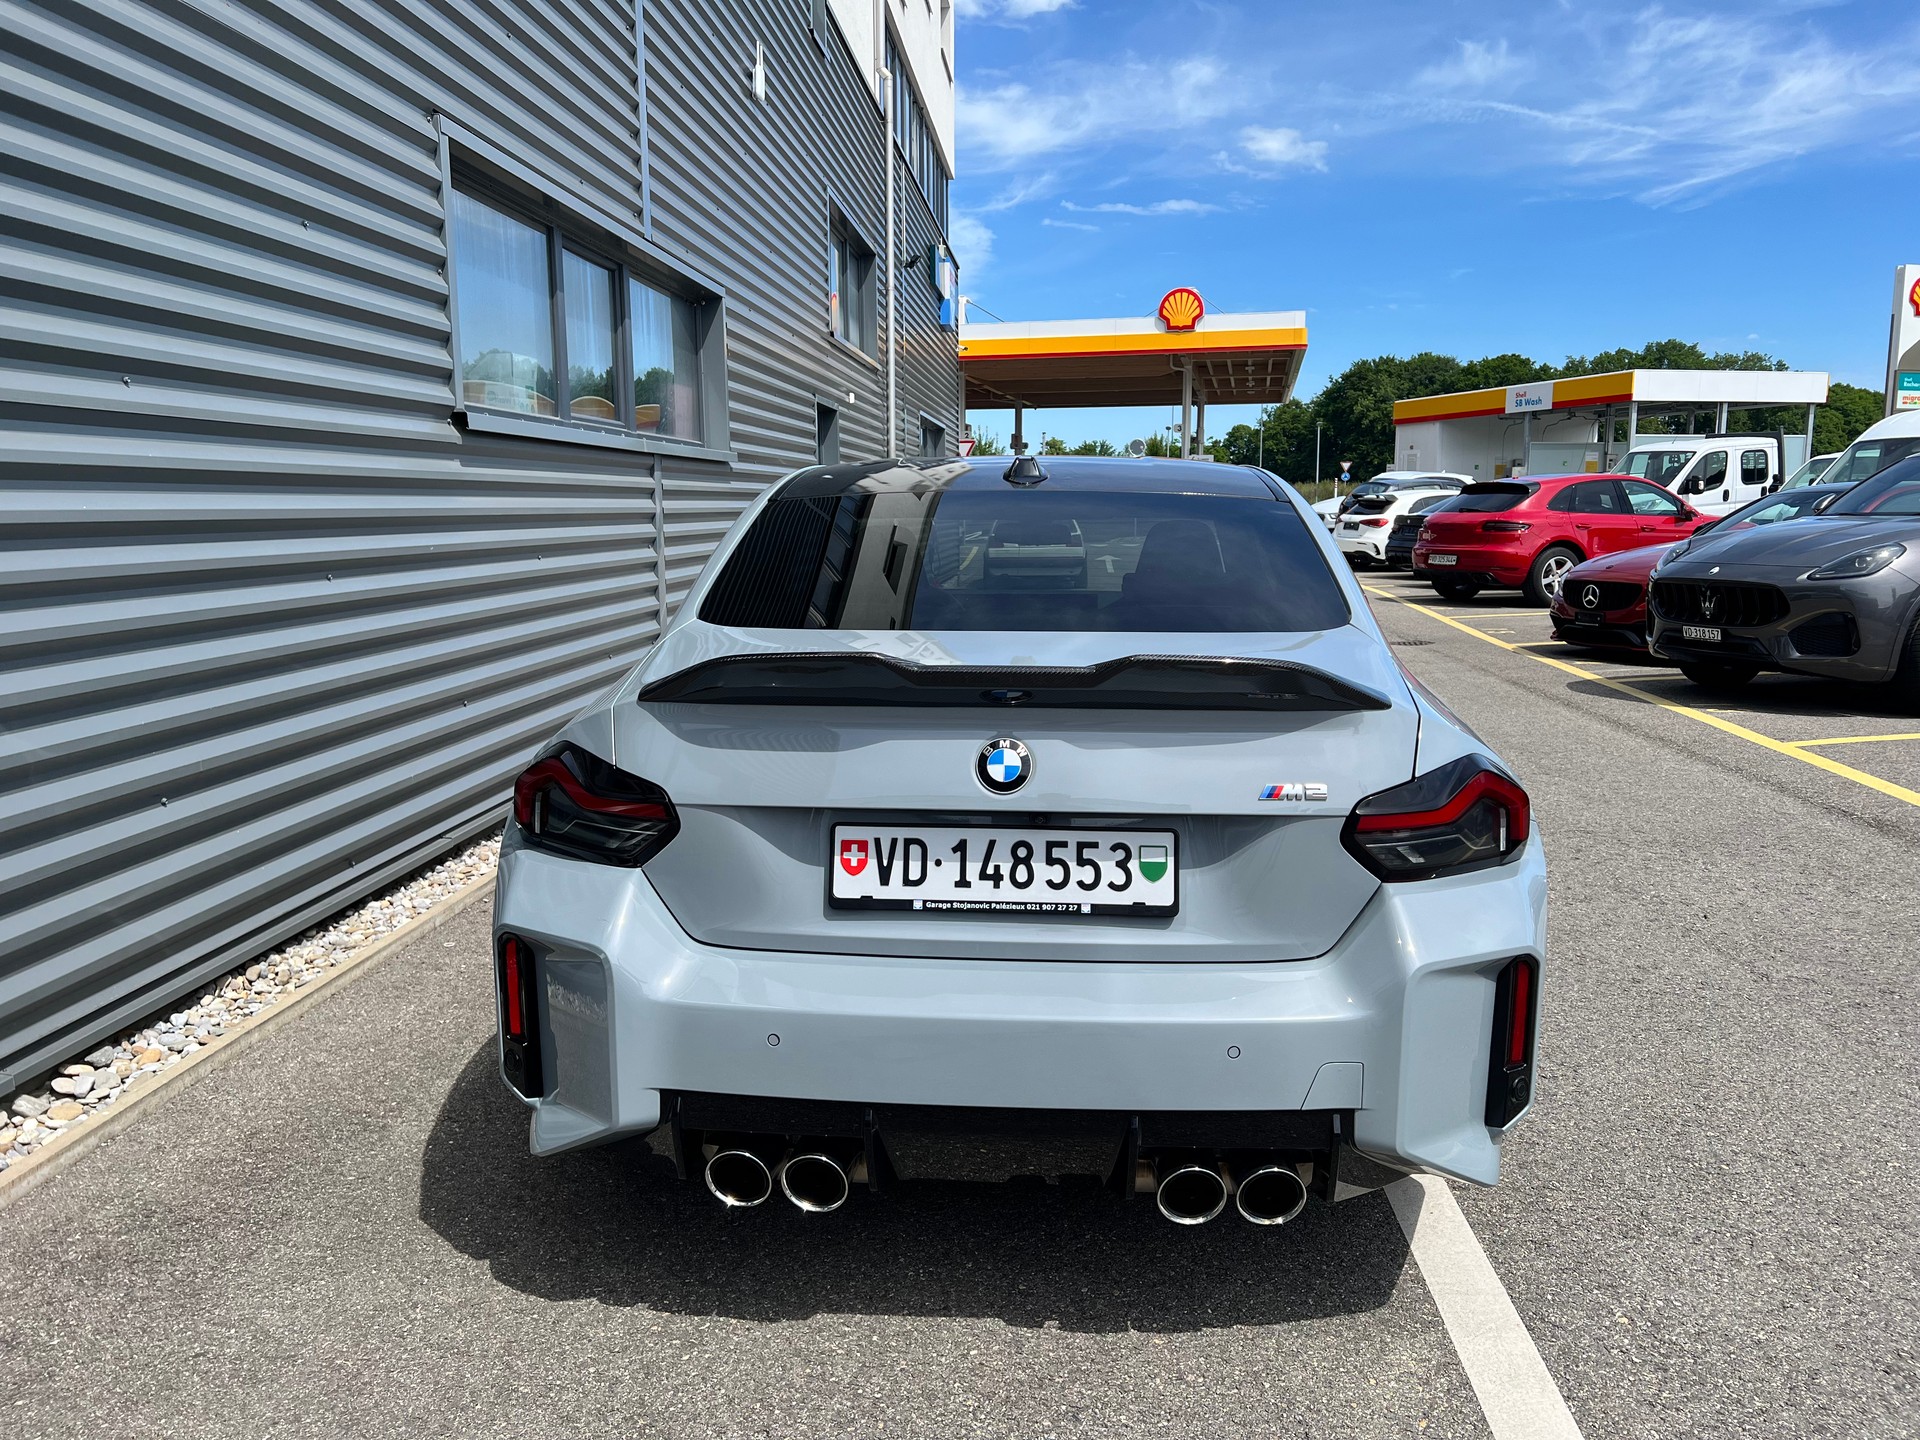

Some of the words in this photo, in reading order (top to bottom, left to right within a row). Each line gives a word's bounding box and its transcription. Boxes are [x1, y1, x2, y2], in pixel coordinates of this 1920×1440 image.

[1515, 391, 1527, 399] Shell
[1514, 398, 1523, 408] SB
[1524, 396, 1543, 407] Wash
[983, 739, 1028, 757] BMW
[1275, 783, 1328, 801] M2
[925, 901, 951, 909] Garage
[952, 902, 990, 910] Stojanovic
[991, 902, 1025, 910] Palézieux
[1026, 903, 1040, 911] 021
